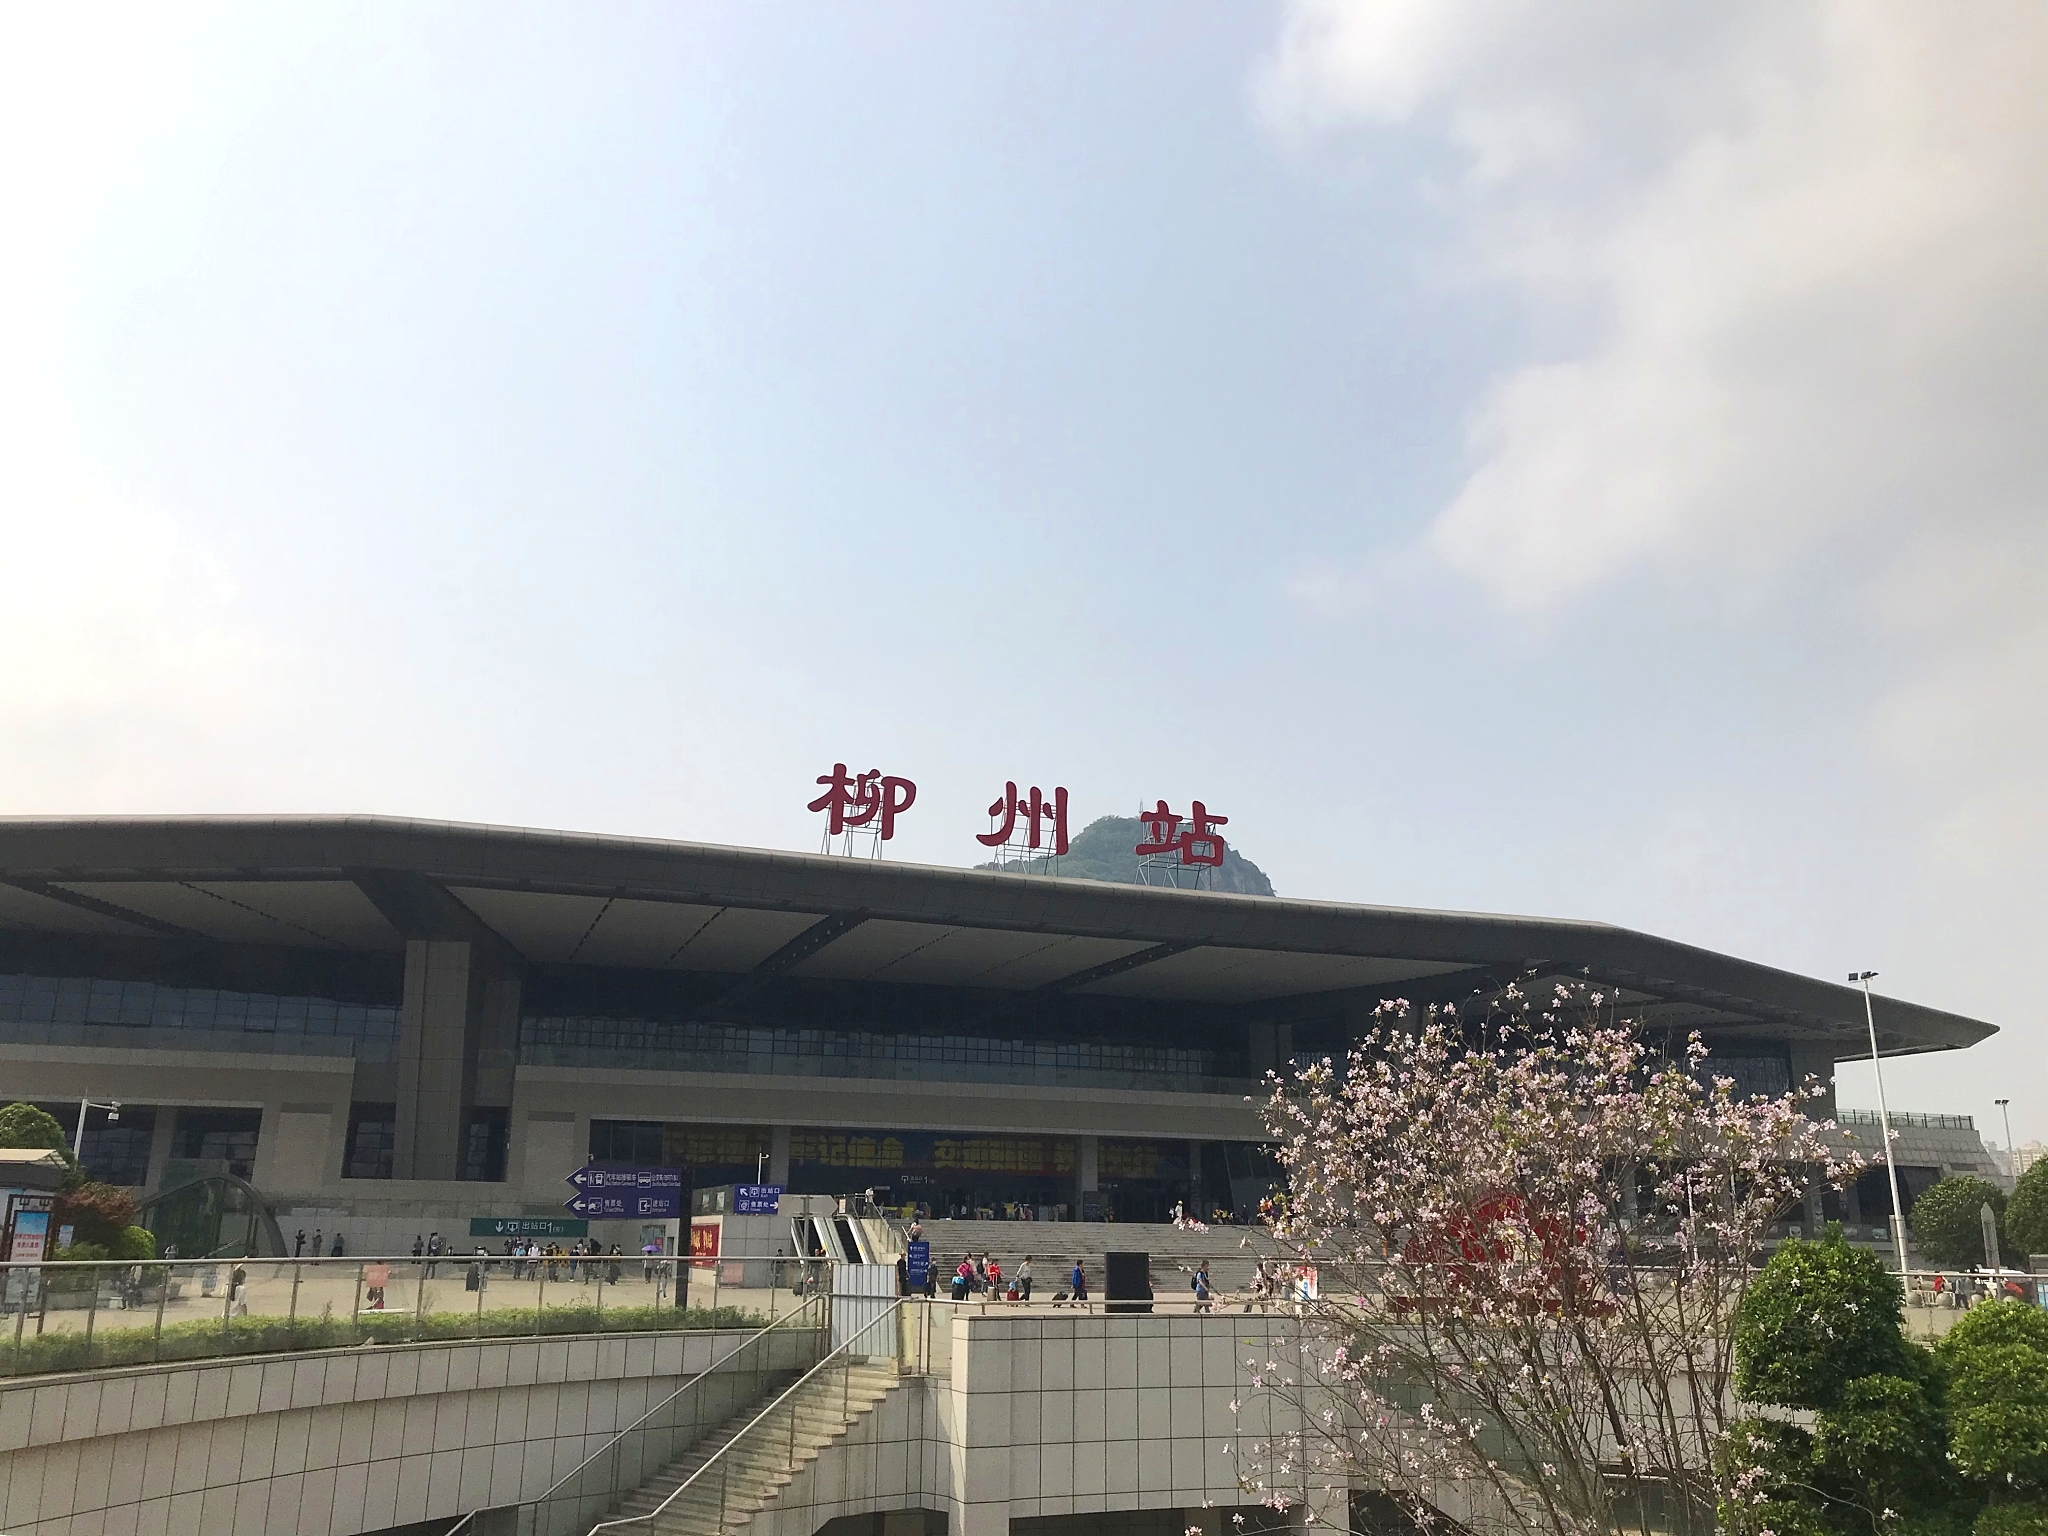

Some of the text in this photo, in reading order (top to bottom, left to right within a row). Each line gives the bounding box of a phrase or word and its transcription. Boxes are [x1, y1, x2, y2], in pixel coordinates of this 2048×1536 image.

[807, 762, 1229, 867] 柳州站
[604, 1199, 622, 1207] 售票处
